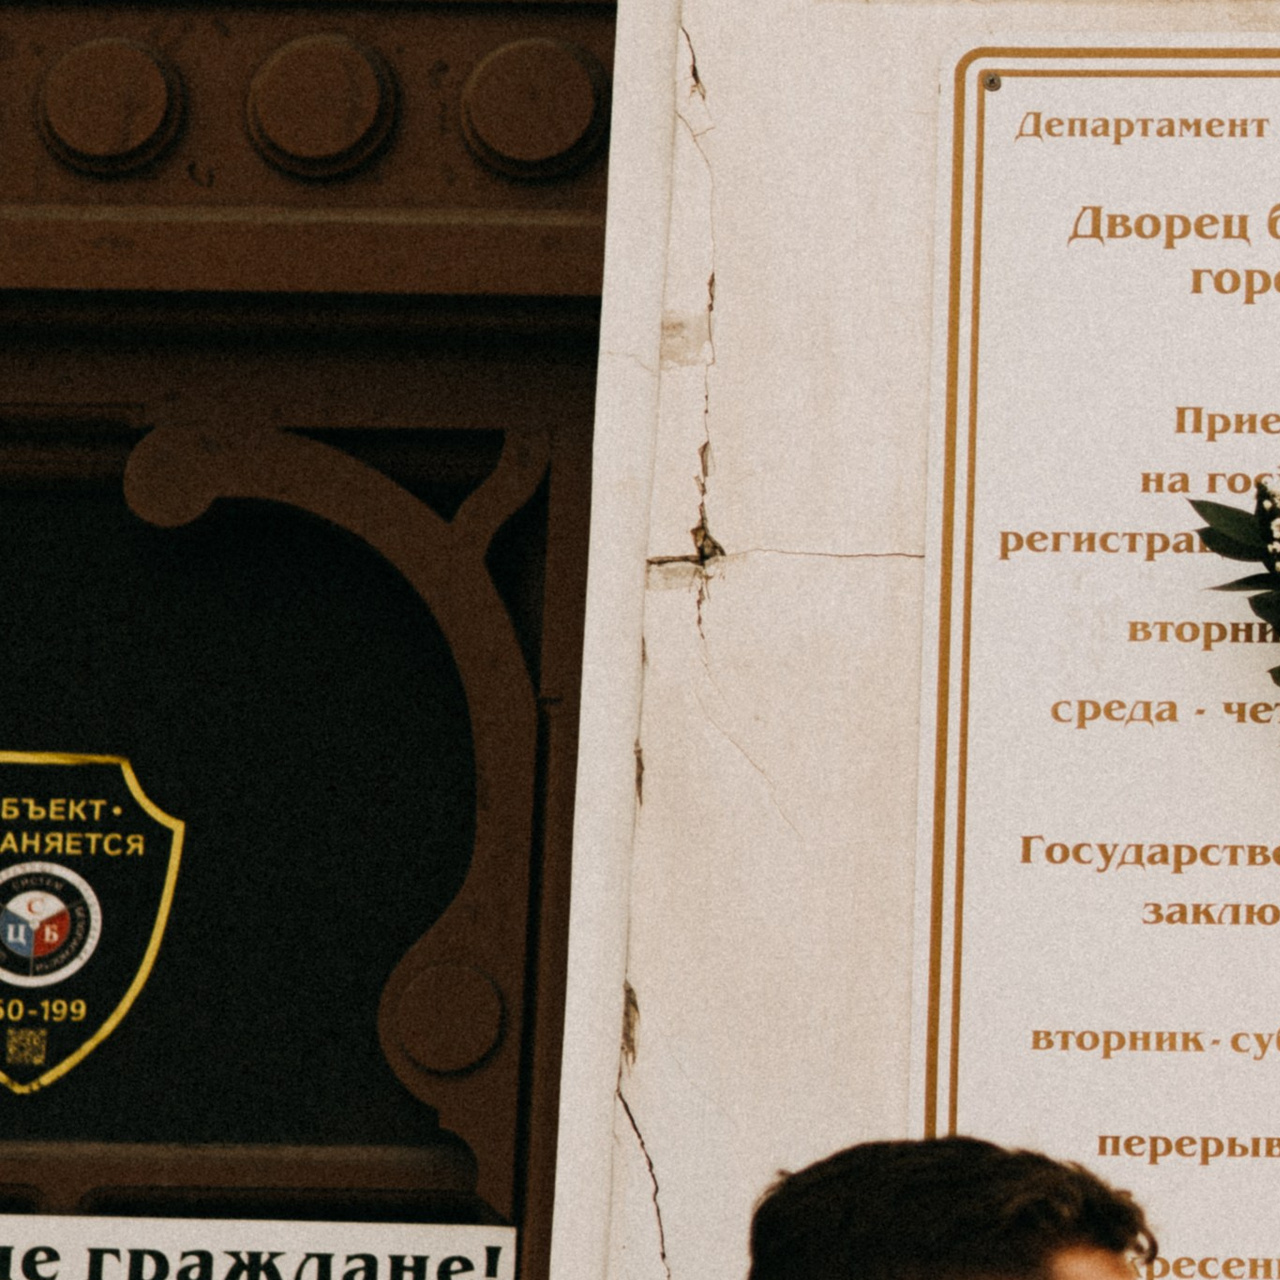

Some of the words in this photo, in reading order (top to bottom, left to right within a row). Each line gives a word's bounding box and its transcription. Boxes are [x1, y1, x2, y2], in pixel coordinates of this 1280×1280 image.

[1016, 112, 1268, 145] Департамент
[1069, 206, 1249, 249] Дворец
[1142, 473, 1189, 493] на
[1051, 700, 1177, 729] среда
